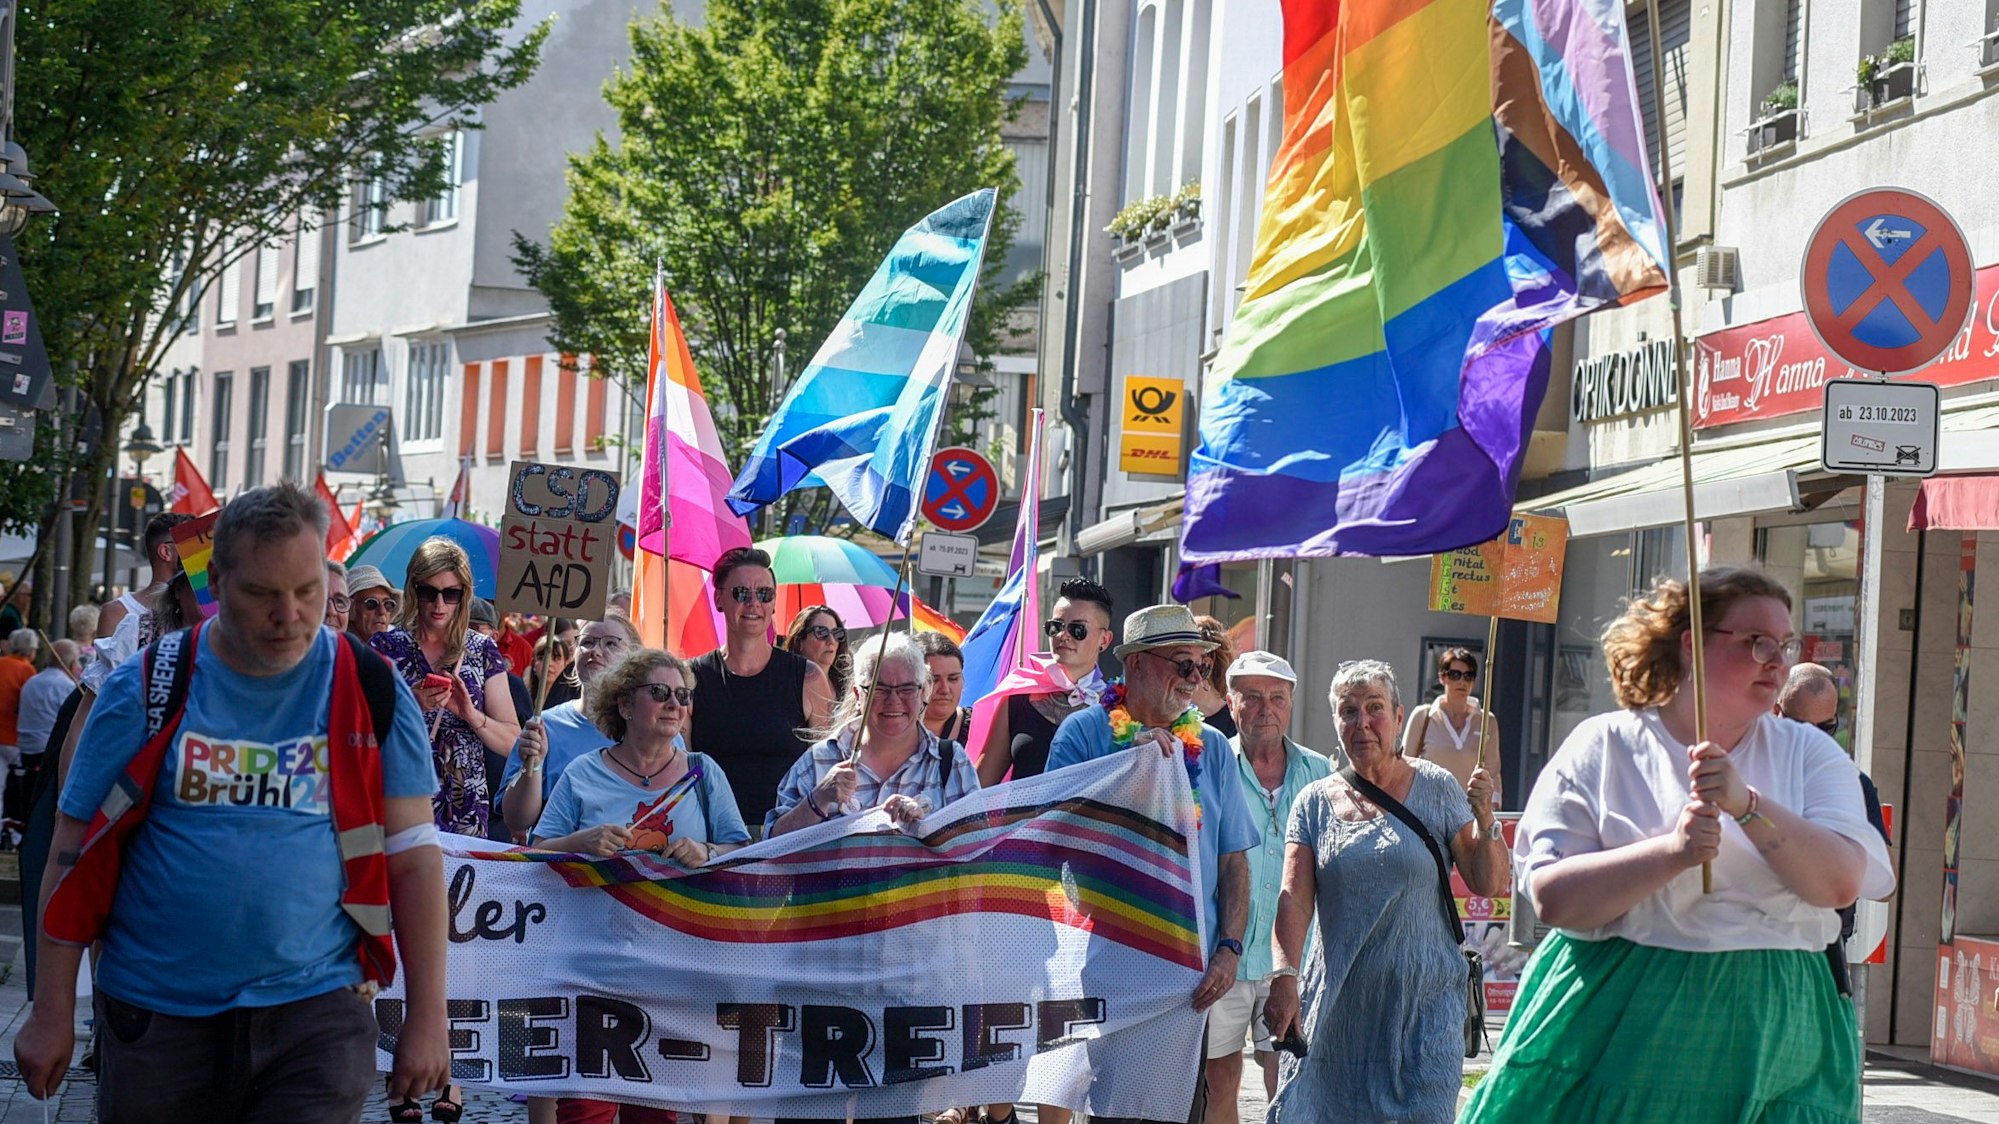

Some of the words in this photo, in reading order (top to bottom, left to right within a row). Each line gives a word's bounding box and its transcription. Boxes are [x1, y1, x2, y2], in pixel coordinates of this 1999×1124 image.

[1614, 331, 1692, 412] DÖNNE
[1711, 350, 1742, 382] Hanna
[1744, 334, 1826, 411] Hanna
[329, 410, 388, 468] Betten
[1839, 406, 1853, 420] ab
[1859, 406, 1917, 422] 23.10.2023
[1130, 448, 1171, 460] DHL
[511, 463, 620, 523] CSD
[506, 520, 600, 563] statt
[929, 544, 936, 552] ab
[511, 560, 592, 611] AfD
[447, 863, 547, 944] ler
